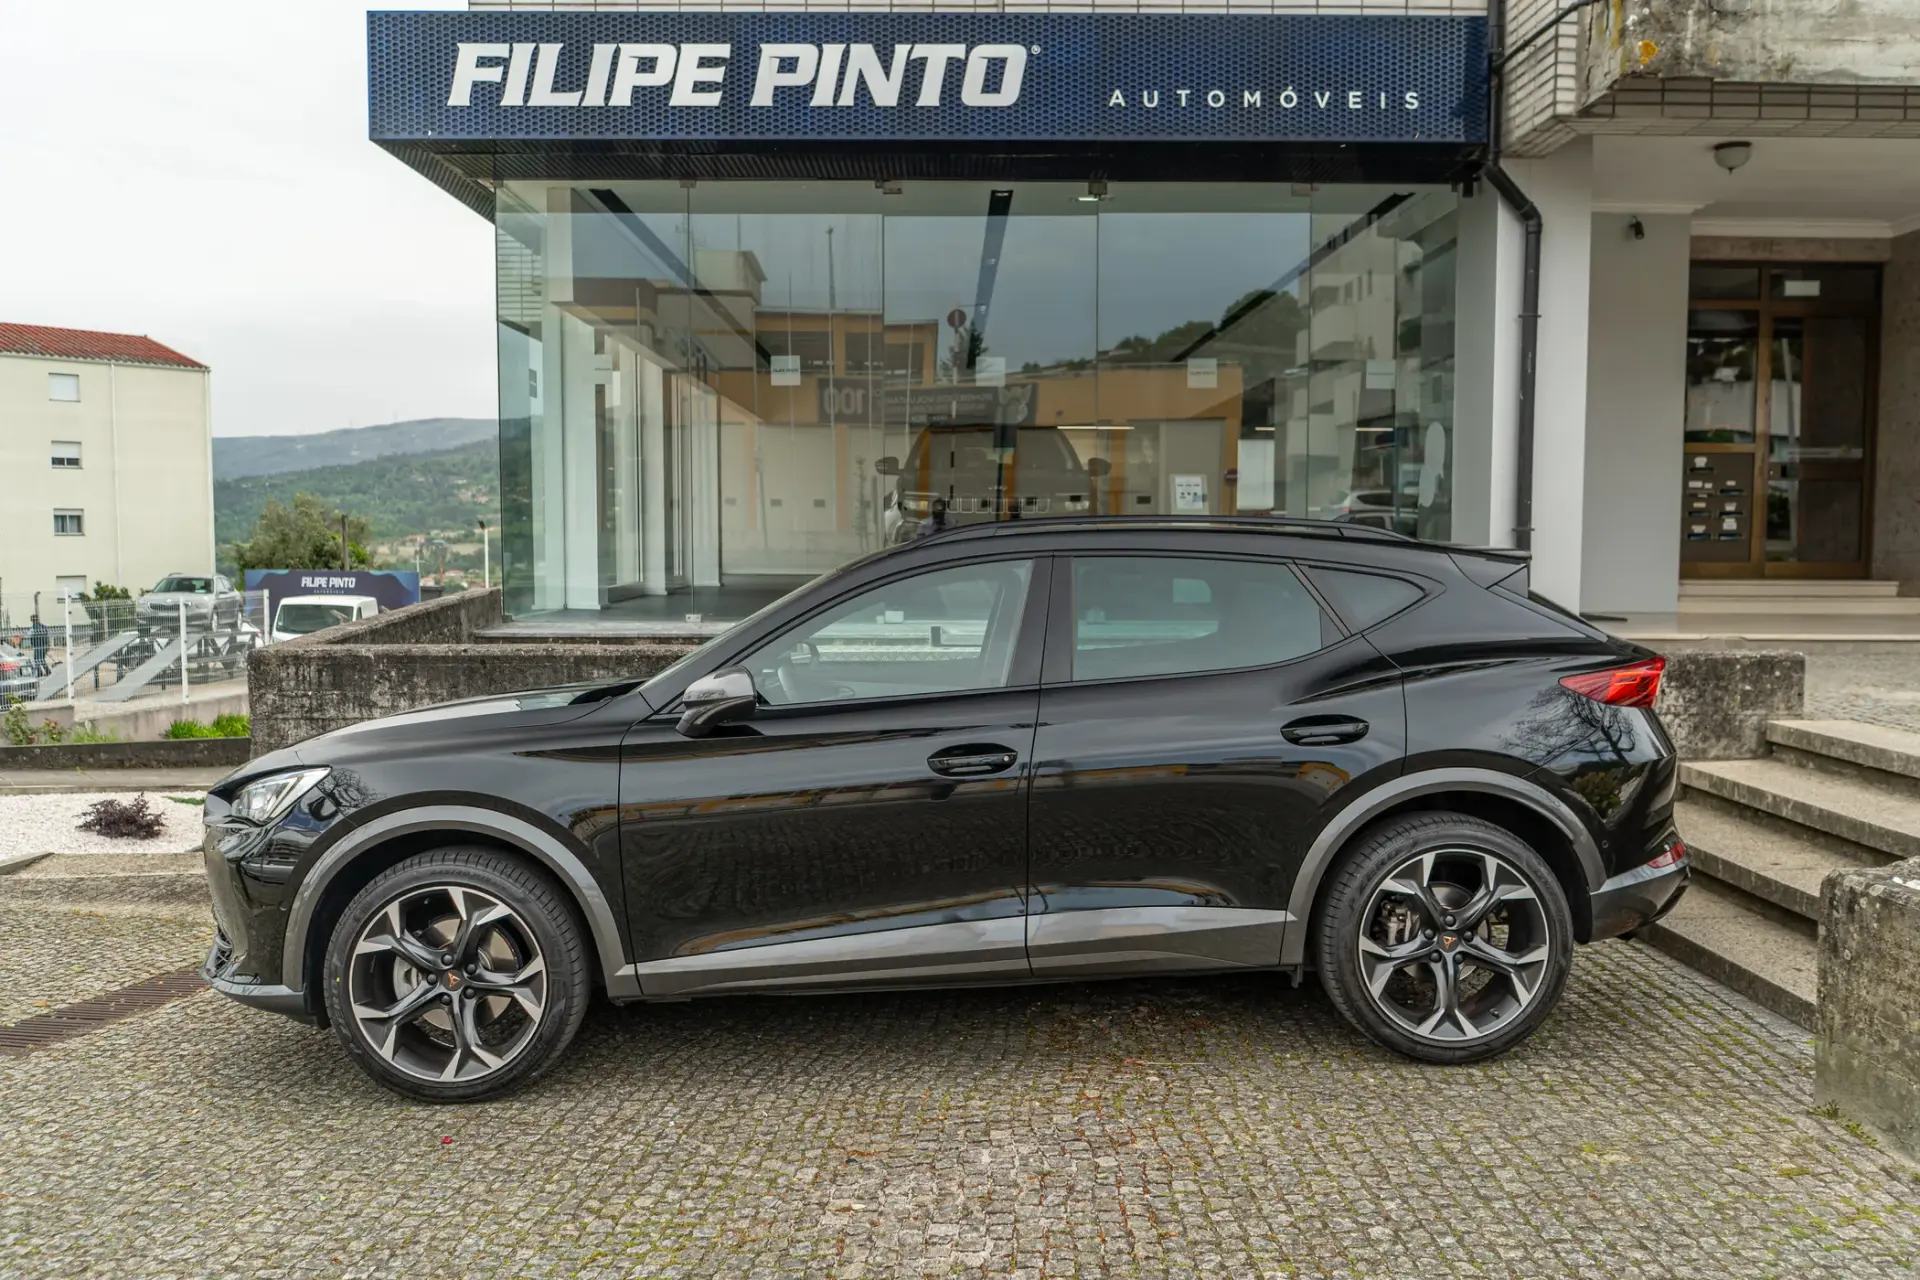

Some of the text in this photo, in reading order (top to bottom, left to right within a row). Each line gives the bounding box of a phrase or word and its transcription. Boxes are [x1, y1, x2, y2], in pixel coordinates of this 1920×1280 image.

[447, 43, 1027, 107] FILIPE PINTO
[1109, 87, 1419, 109] AUTOMÓVEIS
[301, 576, 356, 588] FILIPE PINTO
